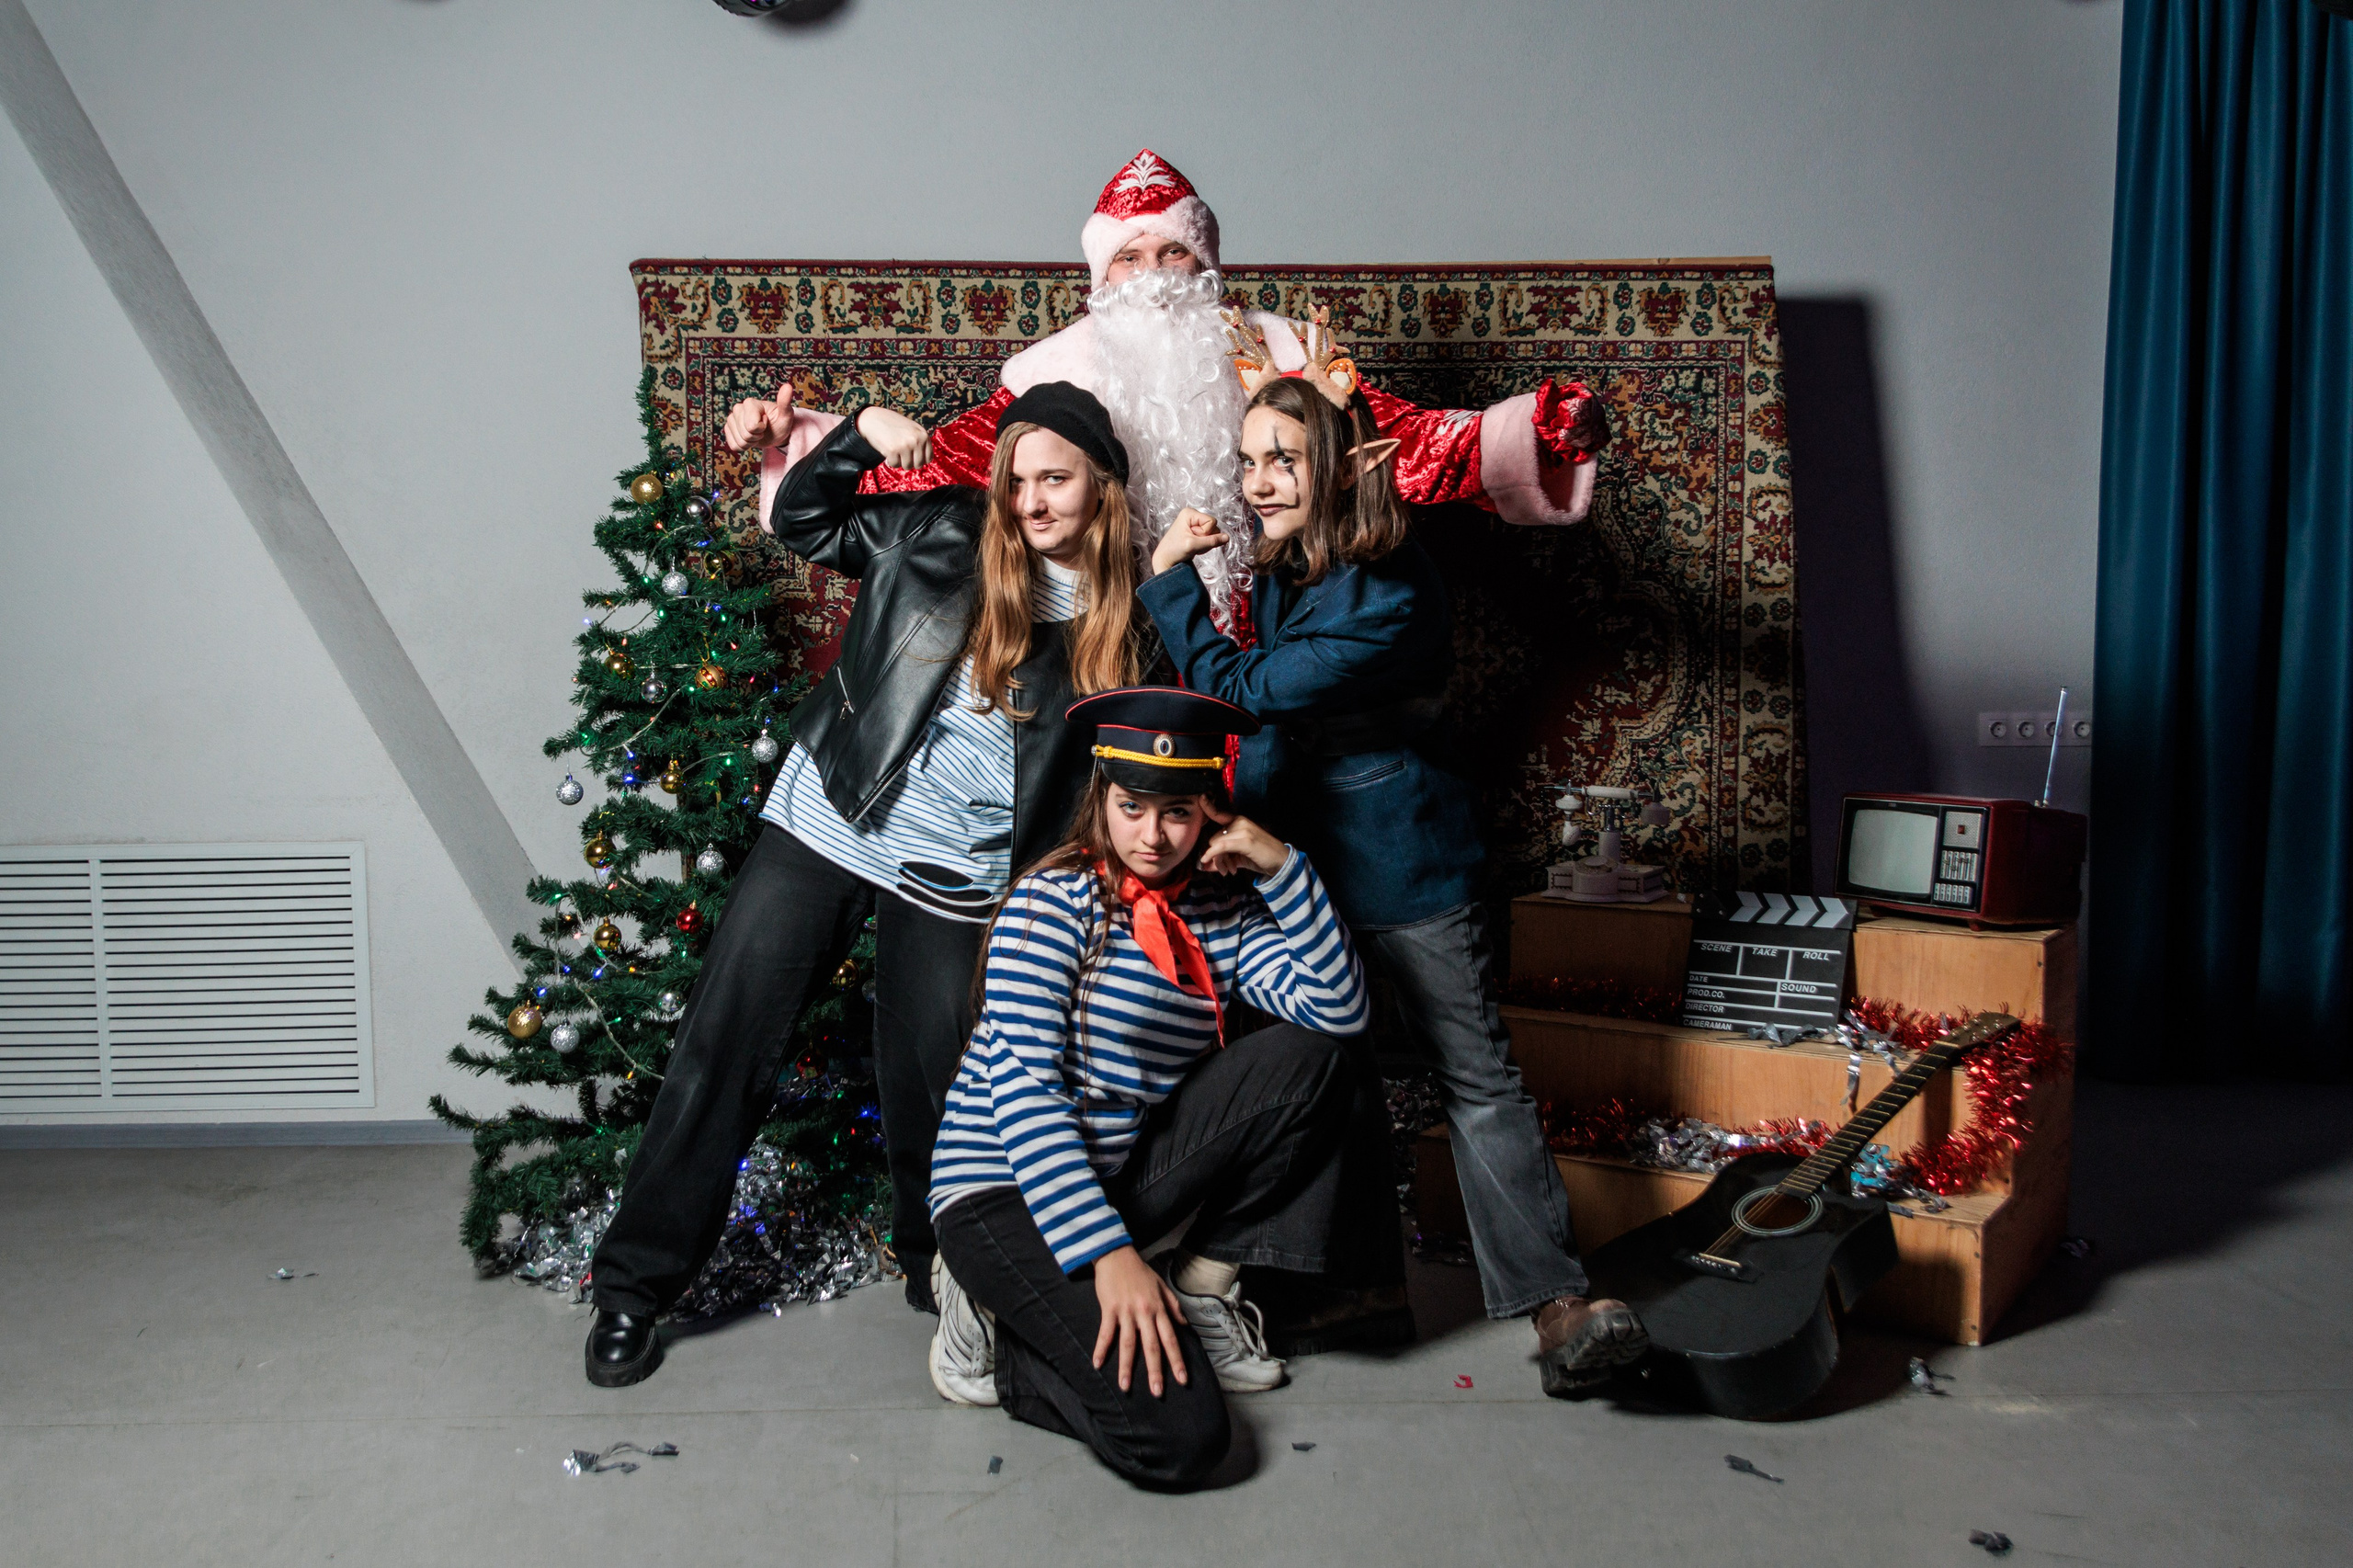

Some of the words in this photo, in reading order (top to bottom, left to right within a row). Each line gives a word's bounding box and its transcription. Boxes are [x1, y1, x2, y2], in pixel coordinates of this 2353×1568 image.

[1700, 943, 1733, 953] SCENE
[1752, 948, 1778, 957] TAKE
[1802, 951, 1830, 960] ROLL
[1687, 988, 1725, 999] PROD.CO.
[1781, 983, 1817, 994] SOUND
[1685, 1003, 1724, 1013] DIRECTOR
[1683, 1018, 1732, 1031] CAMERAMAN
